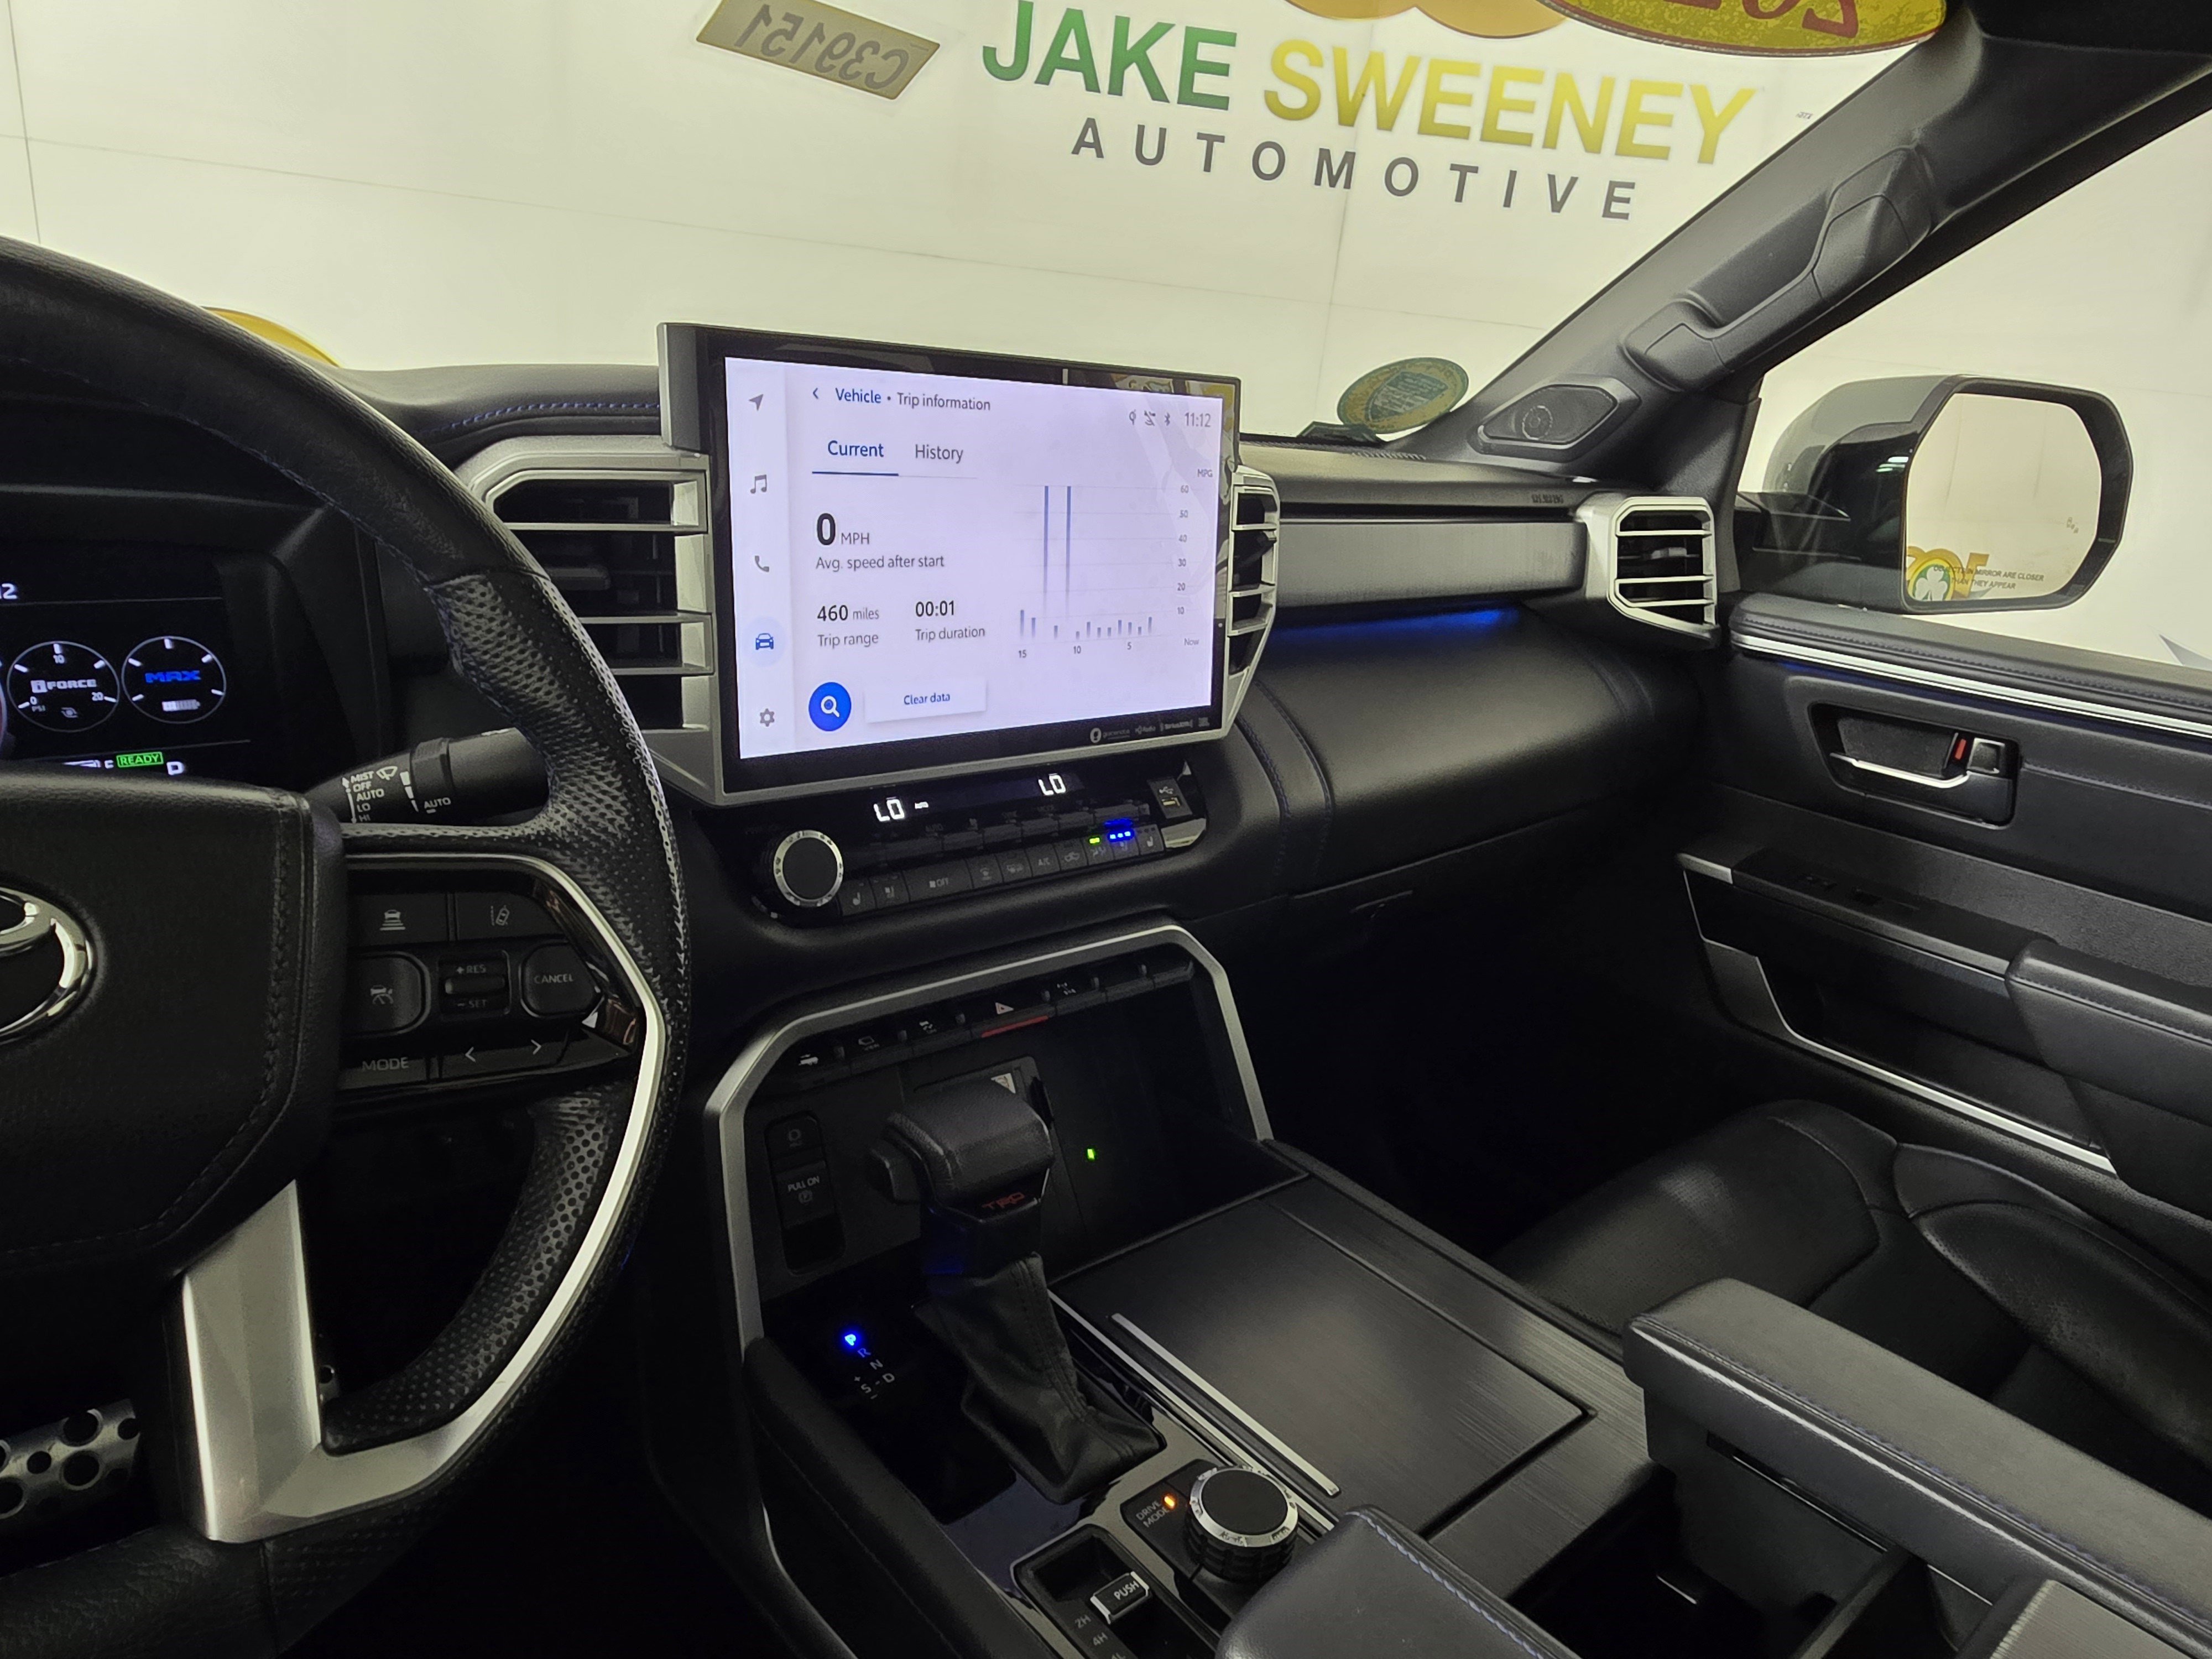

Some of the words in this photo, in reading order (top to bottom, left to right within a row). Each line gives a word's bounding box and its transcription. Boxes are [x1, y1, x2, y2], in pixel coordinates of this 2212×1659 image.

[982, 0, 1237, 111] JAKE
[1264, 39, 1755, 164] SWEENEY
[1071, 117, 1636, 221] AUTOMOTIVE
[836, 388, 881, 404] Vehicle
[897, 392, 920, 409] Trip
[923, 393, 990, 411] information
[1185, 413, 1211, 427] 11:12
[828, 441, 884, 457] Current
[915, 444, 963, 464] History
[1197, 469, 1213, 478] MPG
[1180, 485, 1189, 493] 60
[1180, 510, 1188, 518] 50
[816, 513, 836, 545] 0
[841, 533, 870, 545] MPH
[1178, 534, 1187, 542] 40
[816, 556, 843, 572] Avg.
[847, 556, 884, 571] speed
[888, 555, 915, 568] after
[918, 556, 945, 568] start
[1178, 559, 1187, 567] 30
[1976, 568, 2002, 577] MIRROR
[2002, 571, 2016, 579] ARE
[2018, 572, 2044, 581] CLOSER
[1177, 583, 1186, 591] 20
[1990, 581, 2016, 589] APPEAR
[817, 604, 848, 622] 460
[852, 608, 879, 620] miles
[915, 601, 955, 617] 00:01
[818, 634, 840, 648] Trip
[844, 634, 879, 648] range
[915, 628, 936, 642] Trip
[938, 626, 985, 640] duration
[1019, 650, 1027, 659] 15
[1073, 645, 1081, 654] 10
[1127, 641, 1132, 650] 5
[1183, 638, 1199, 646] Now
[145, 671, 201, 683] MAX
[904, 694, 927, 706] Clear
[930, 692, 950, 703] data
[119, 754, 160, 766] READY
[351, 771, 374, 783] MIST
[353, 782, 371, 792] OFF
[356, 788, 384, 801] AUTO
[874, 799, 905, 822] LO
[1038, 775, 1066, 796] LO
[357, 803, 371, 812] LO
[424, 797, 451, 809] AUTO
[533, 974, 574, 984] CANCEL
[362, 1056, 409, 1071] MODE
[787, 1181, 806, 1192] PULL
[807, 1176, 820, 1187] ON
[1136, 1500, 1161, 1521] DRIVE
[1143, 1507, 1170, 1527] MODE
[1113, 1579, 1140, 1600] PUSH
[1074, 1614, 1092, 1629] 2H
[1092, 1632, 1108, 1647] 4H
